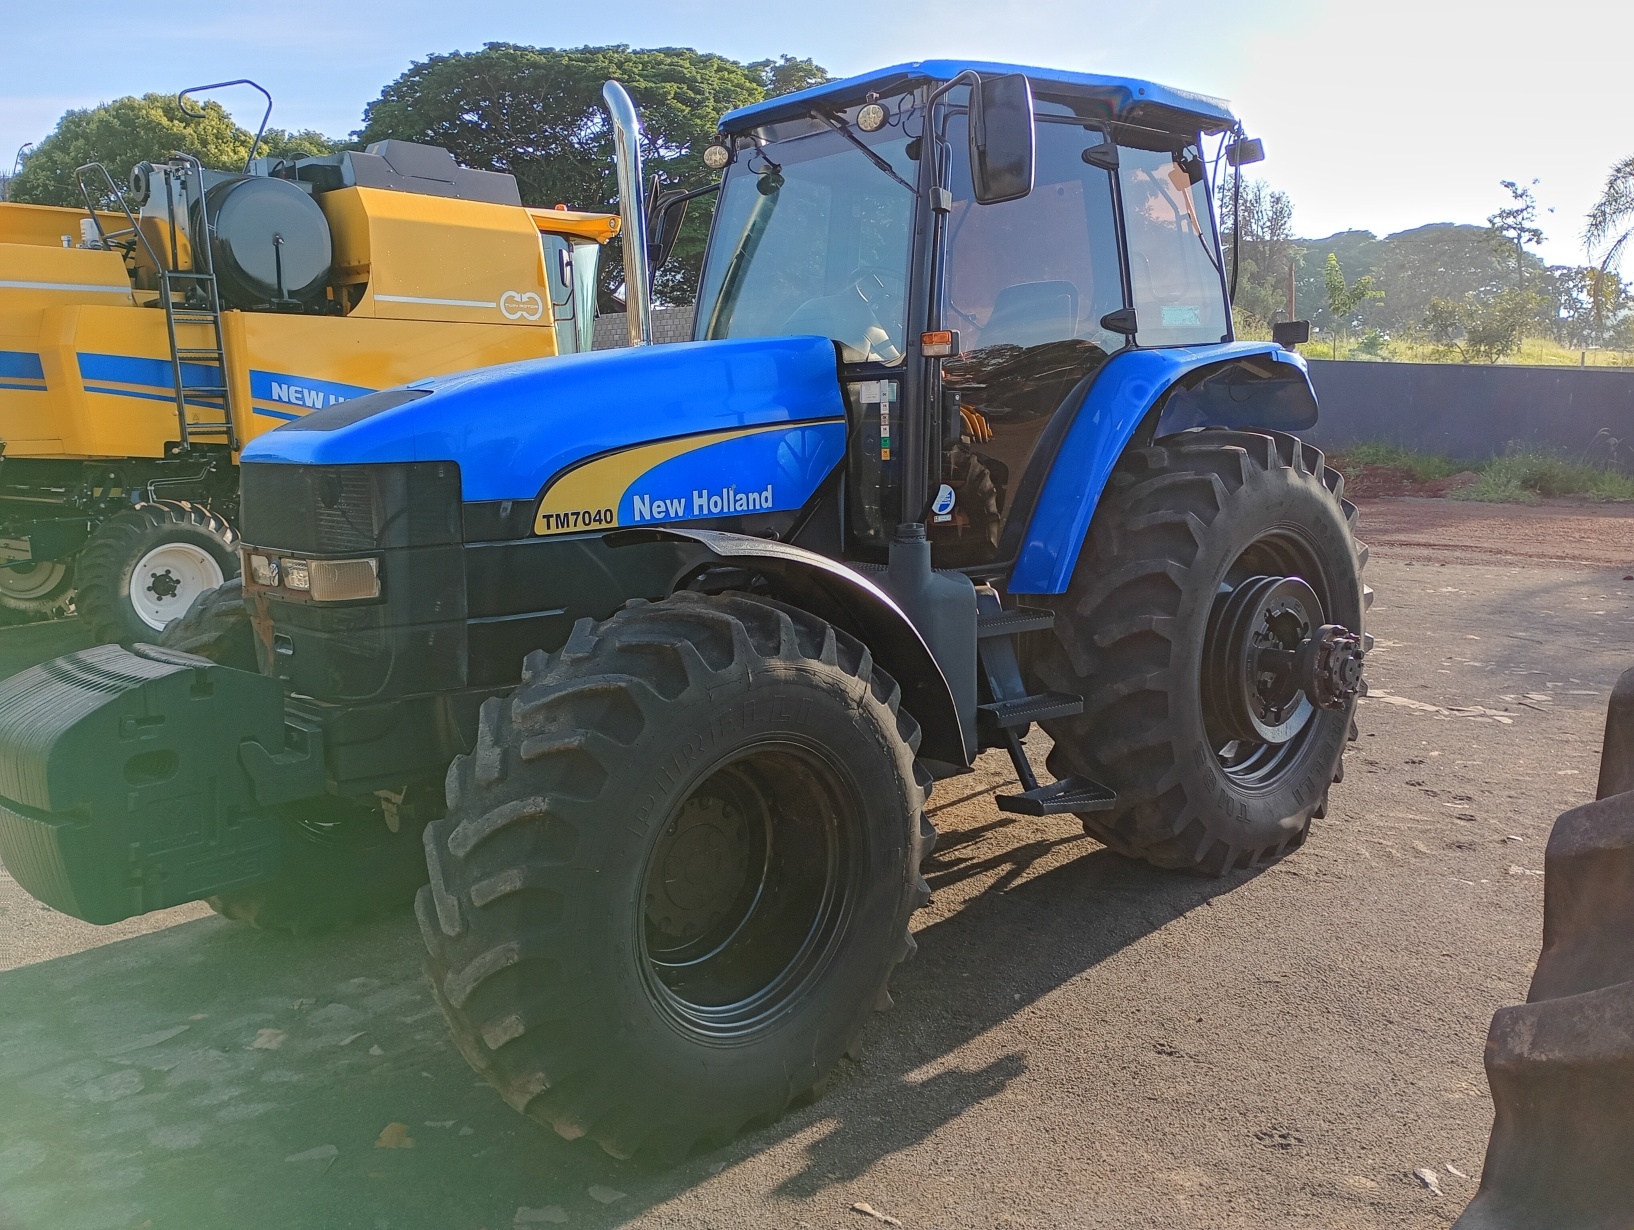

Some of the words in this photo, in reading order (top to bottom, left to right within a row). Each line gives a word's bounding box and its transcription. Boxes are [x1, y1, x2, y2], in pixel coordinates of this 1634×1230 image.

[271, 381, 324, 409] NEW
[632, 494, 685, 521] New
[692, 484, 773, 515] Holland
[542, 508, 614, 531] TM7040
[626, 695, 813, 839] PIRELLI
